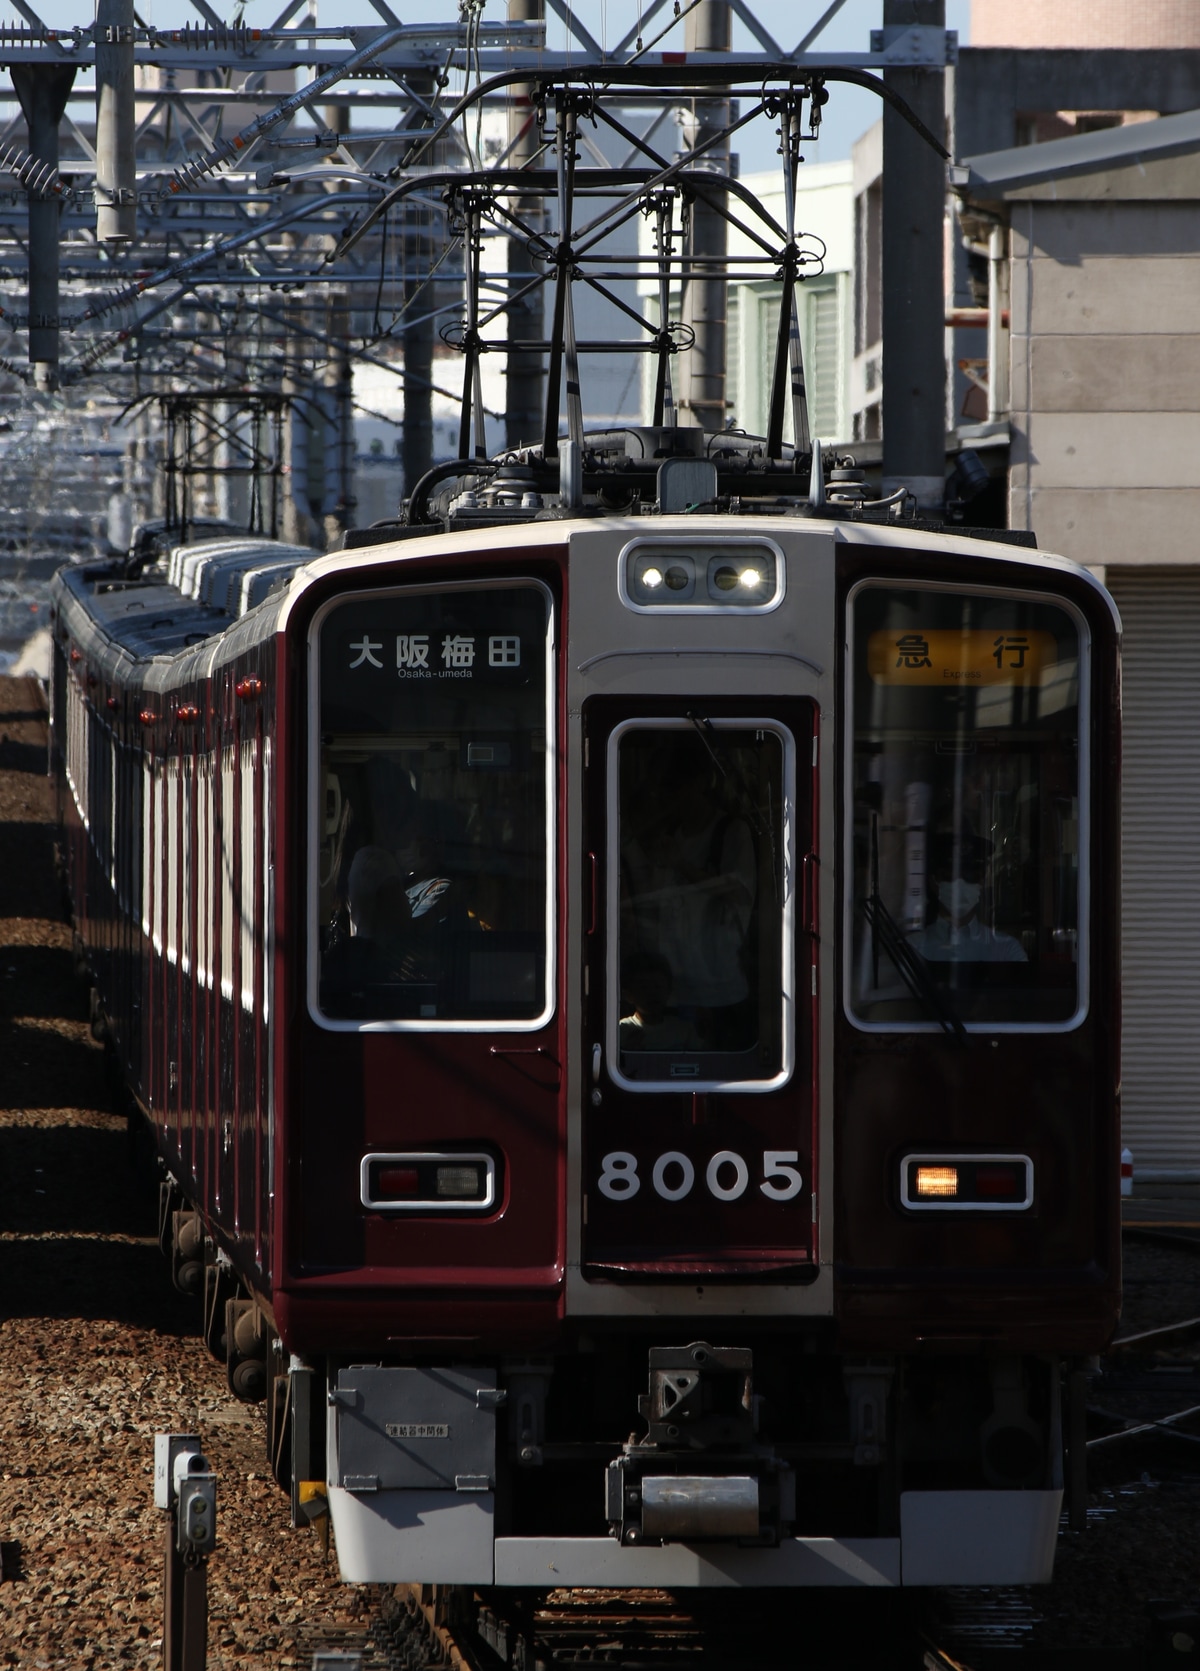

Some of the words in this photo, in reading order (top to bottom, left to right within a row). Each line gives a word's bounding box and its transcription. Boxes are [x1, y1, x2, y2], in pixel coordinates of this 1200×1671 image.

[349, 635, 521, 668] 大阪梅田
[895, 634, 1030, 669] 急行
[397, 668, 473, 678] Osaka-umeda
[943, 669, 982, 680] Express
[597, 1150, 803, 1201] 8005
